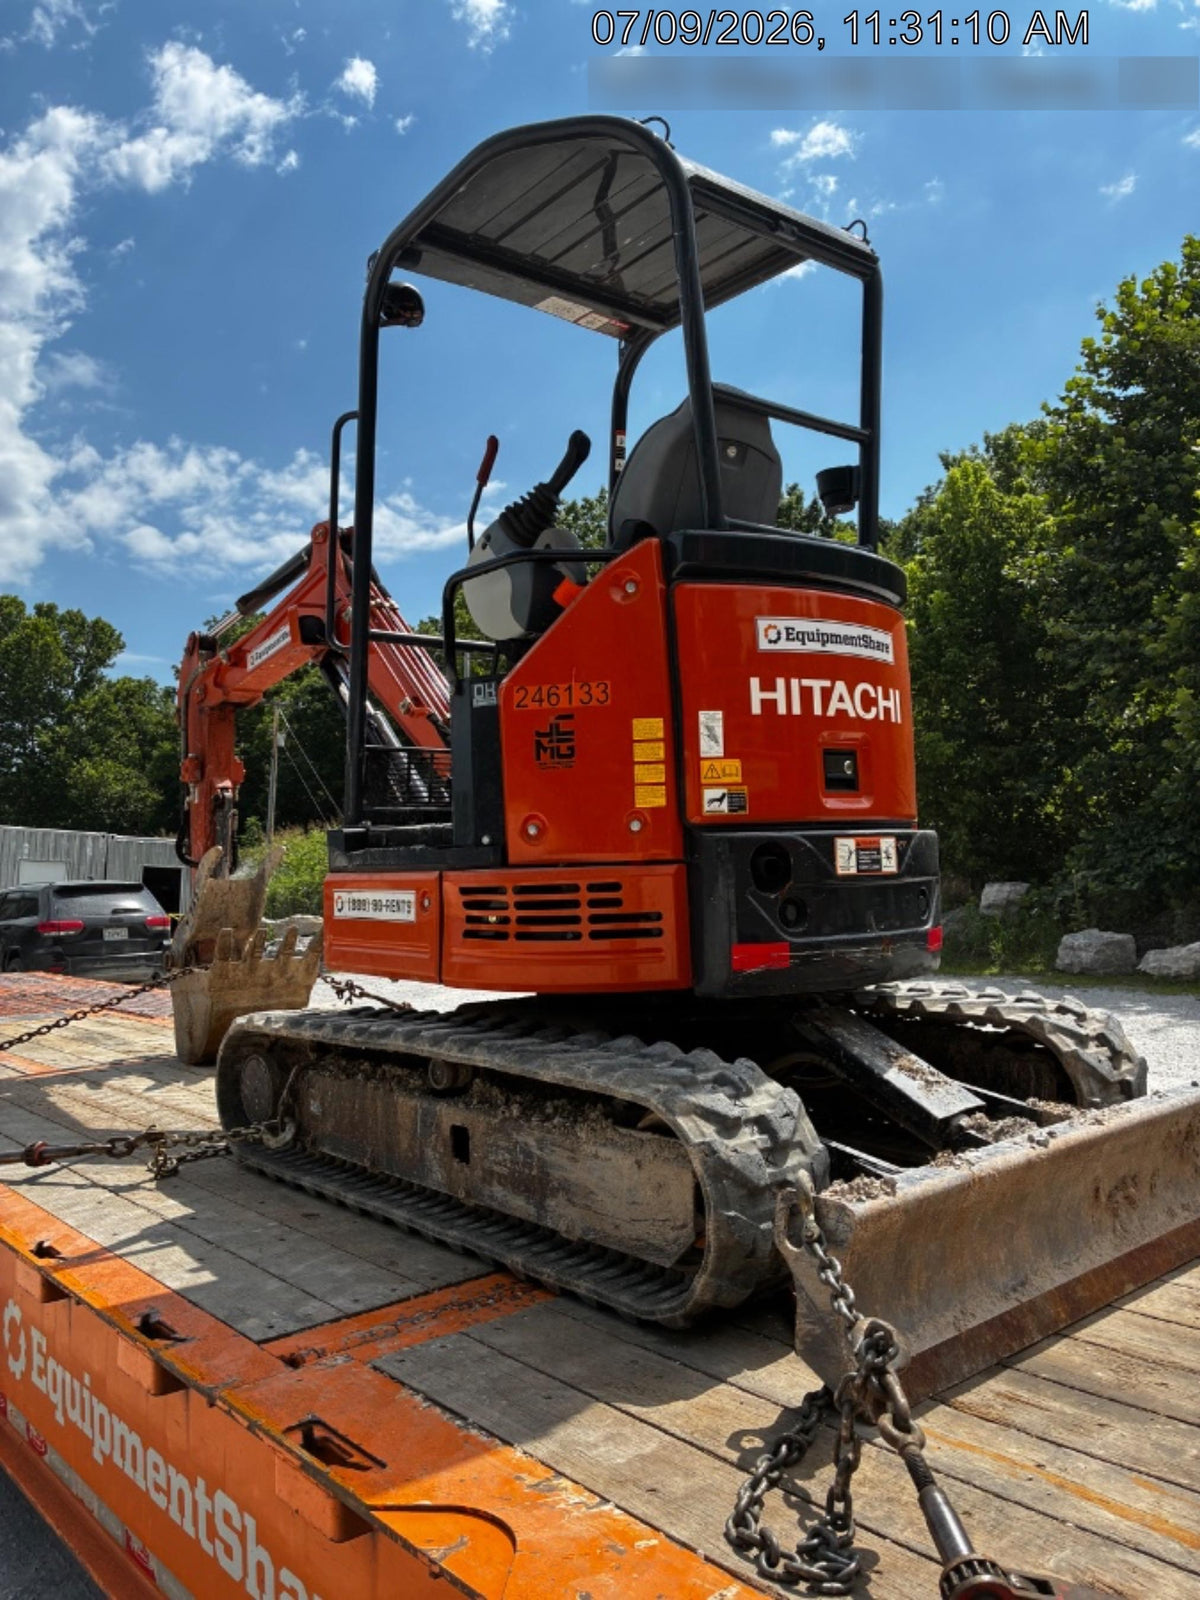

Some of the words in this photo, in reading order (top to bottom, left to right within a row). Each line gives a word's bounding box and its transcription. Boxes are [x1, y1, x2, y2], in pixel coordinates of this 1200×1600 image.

[784, 626, 890, 654] EquipmentShare
[515, 682, 610, 709] 246133
[749, 676, 902, 724] HITACHI
[30, 1325, 322, 1600] EquipmentSha
